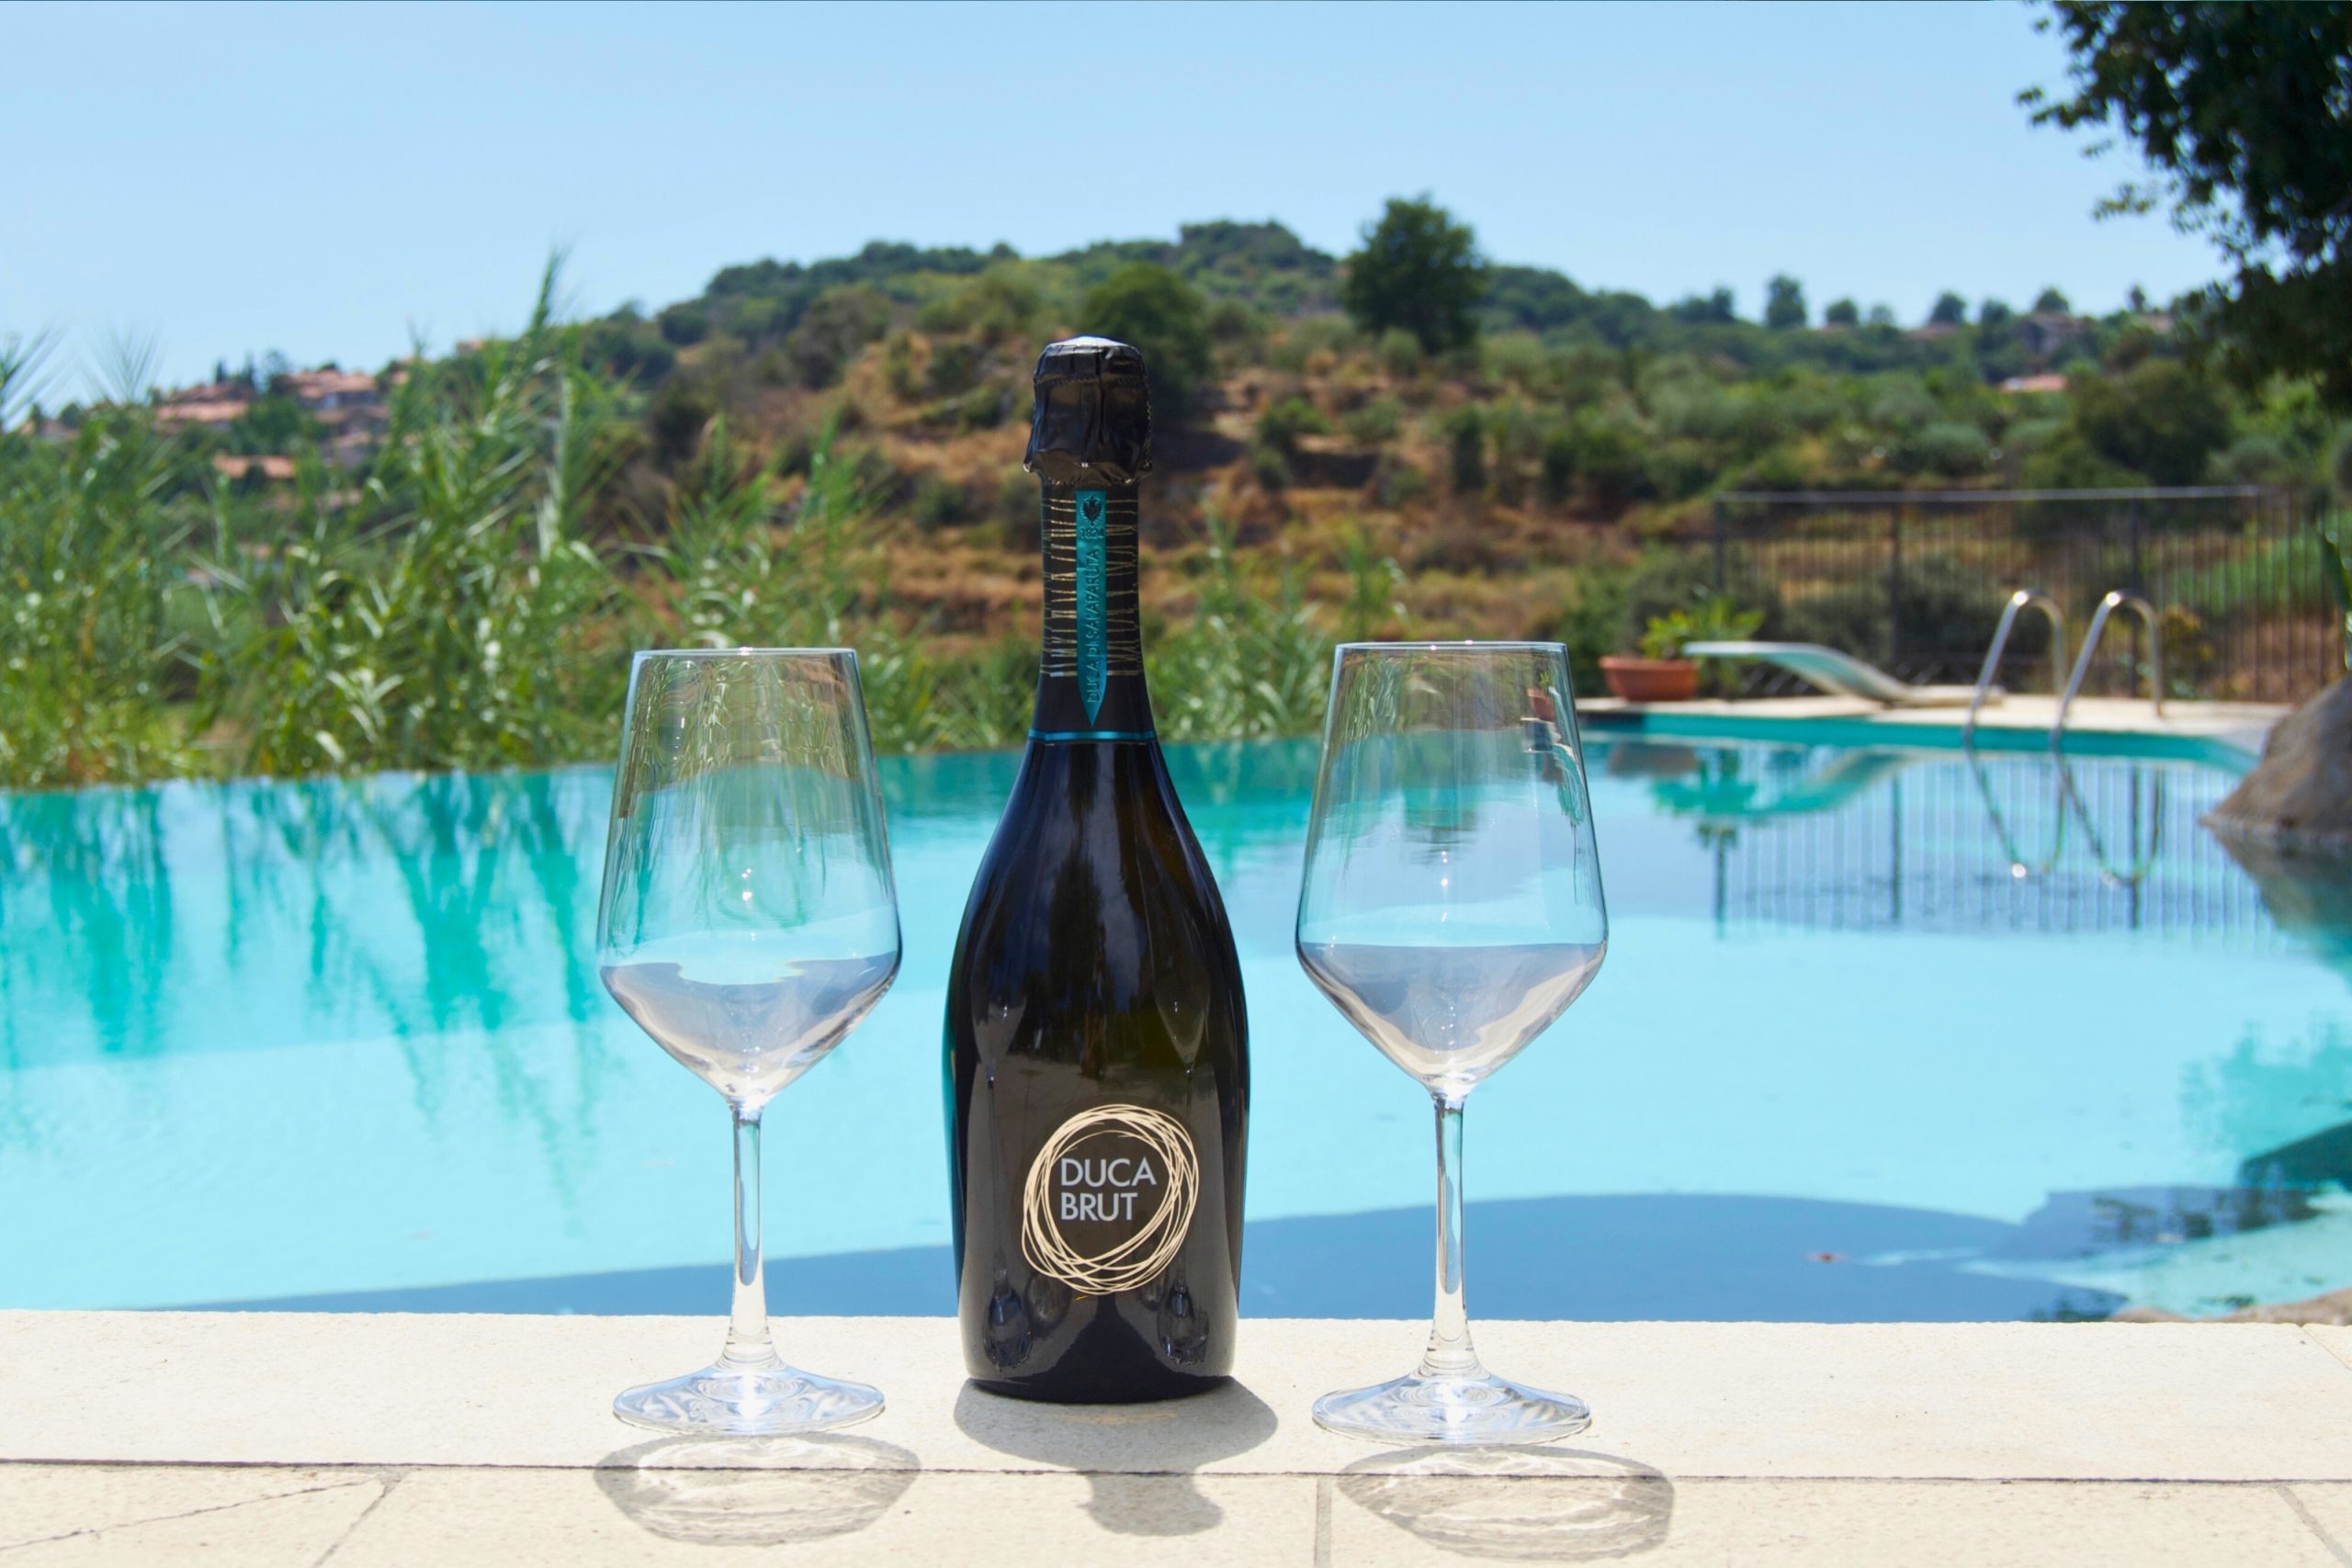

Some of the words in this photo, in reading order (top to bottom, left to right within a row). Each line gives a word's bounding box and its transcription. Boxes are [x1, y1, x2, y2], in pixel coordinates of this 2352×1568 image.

[1085, 549, 1100, 639] SALAPARUTA
[1086, 643, 1100, 658] DI
[1087, 660, 1100, 703] DUCA
[1061, 1156, 1158, 1188] DUCA
[1061, 1192, 1138, 1222] BRUT
